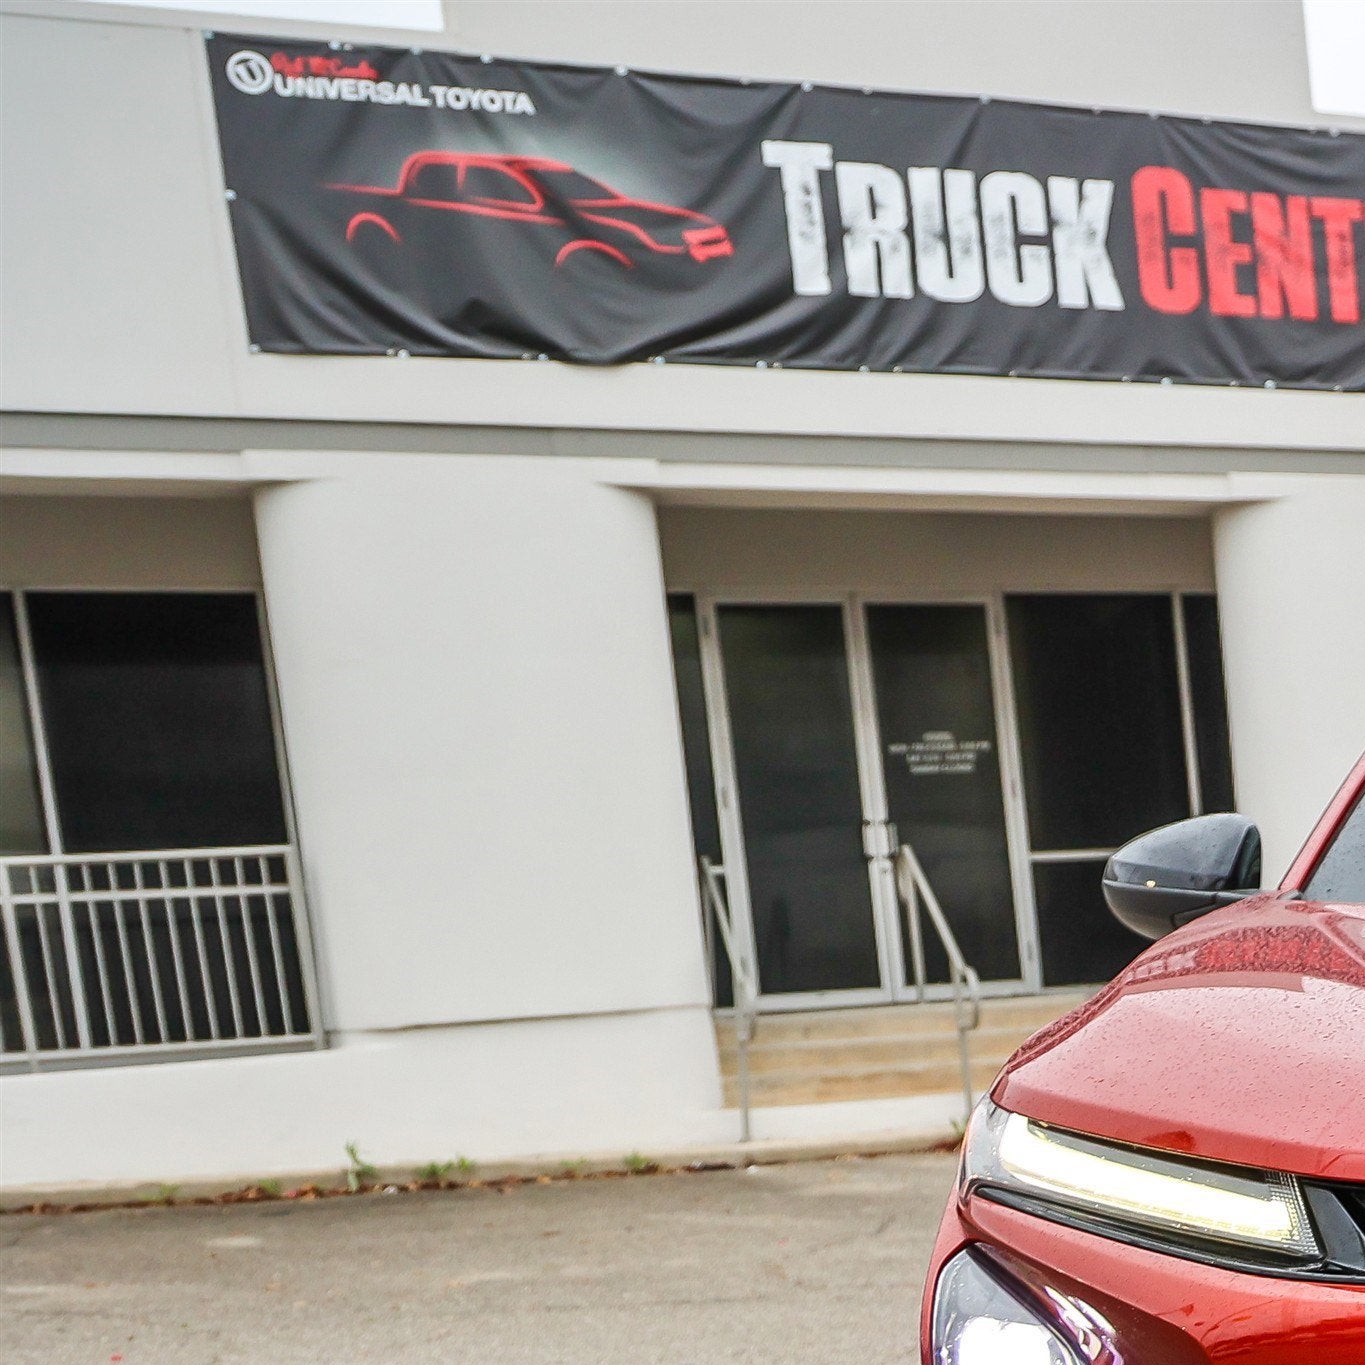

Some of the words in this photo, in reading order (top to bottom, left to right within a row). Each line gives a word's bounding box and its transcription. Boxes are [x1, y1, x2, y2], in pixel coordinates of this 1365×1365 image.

[273, 73, 432, 107] UNIVERSAL
[429, 85, 537, 116] TOYOTA
[760, 139, 1125, 311] TRUCK
